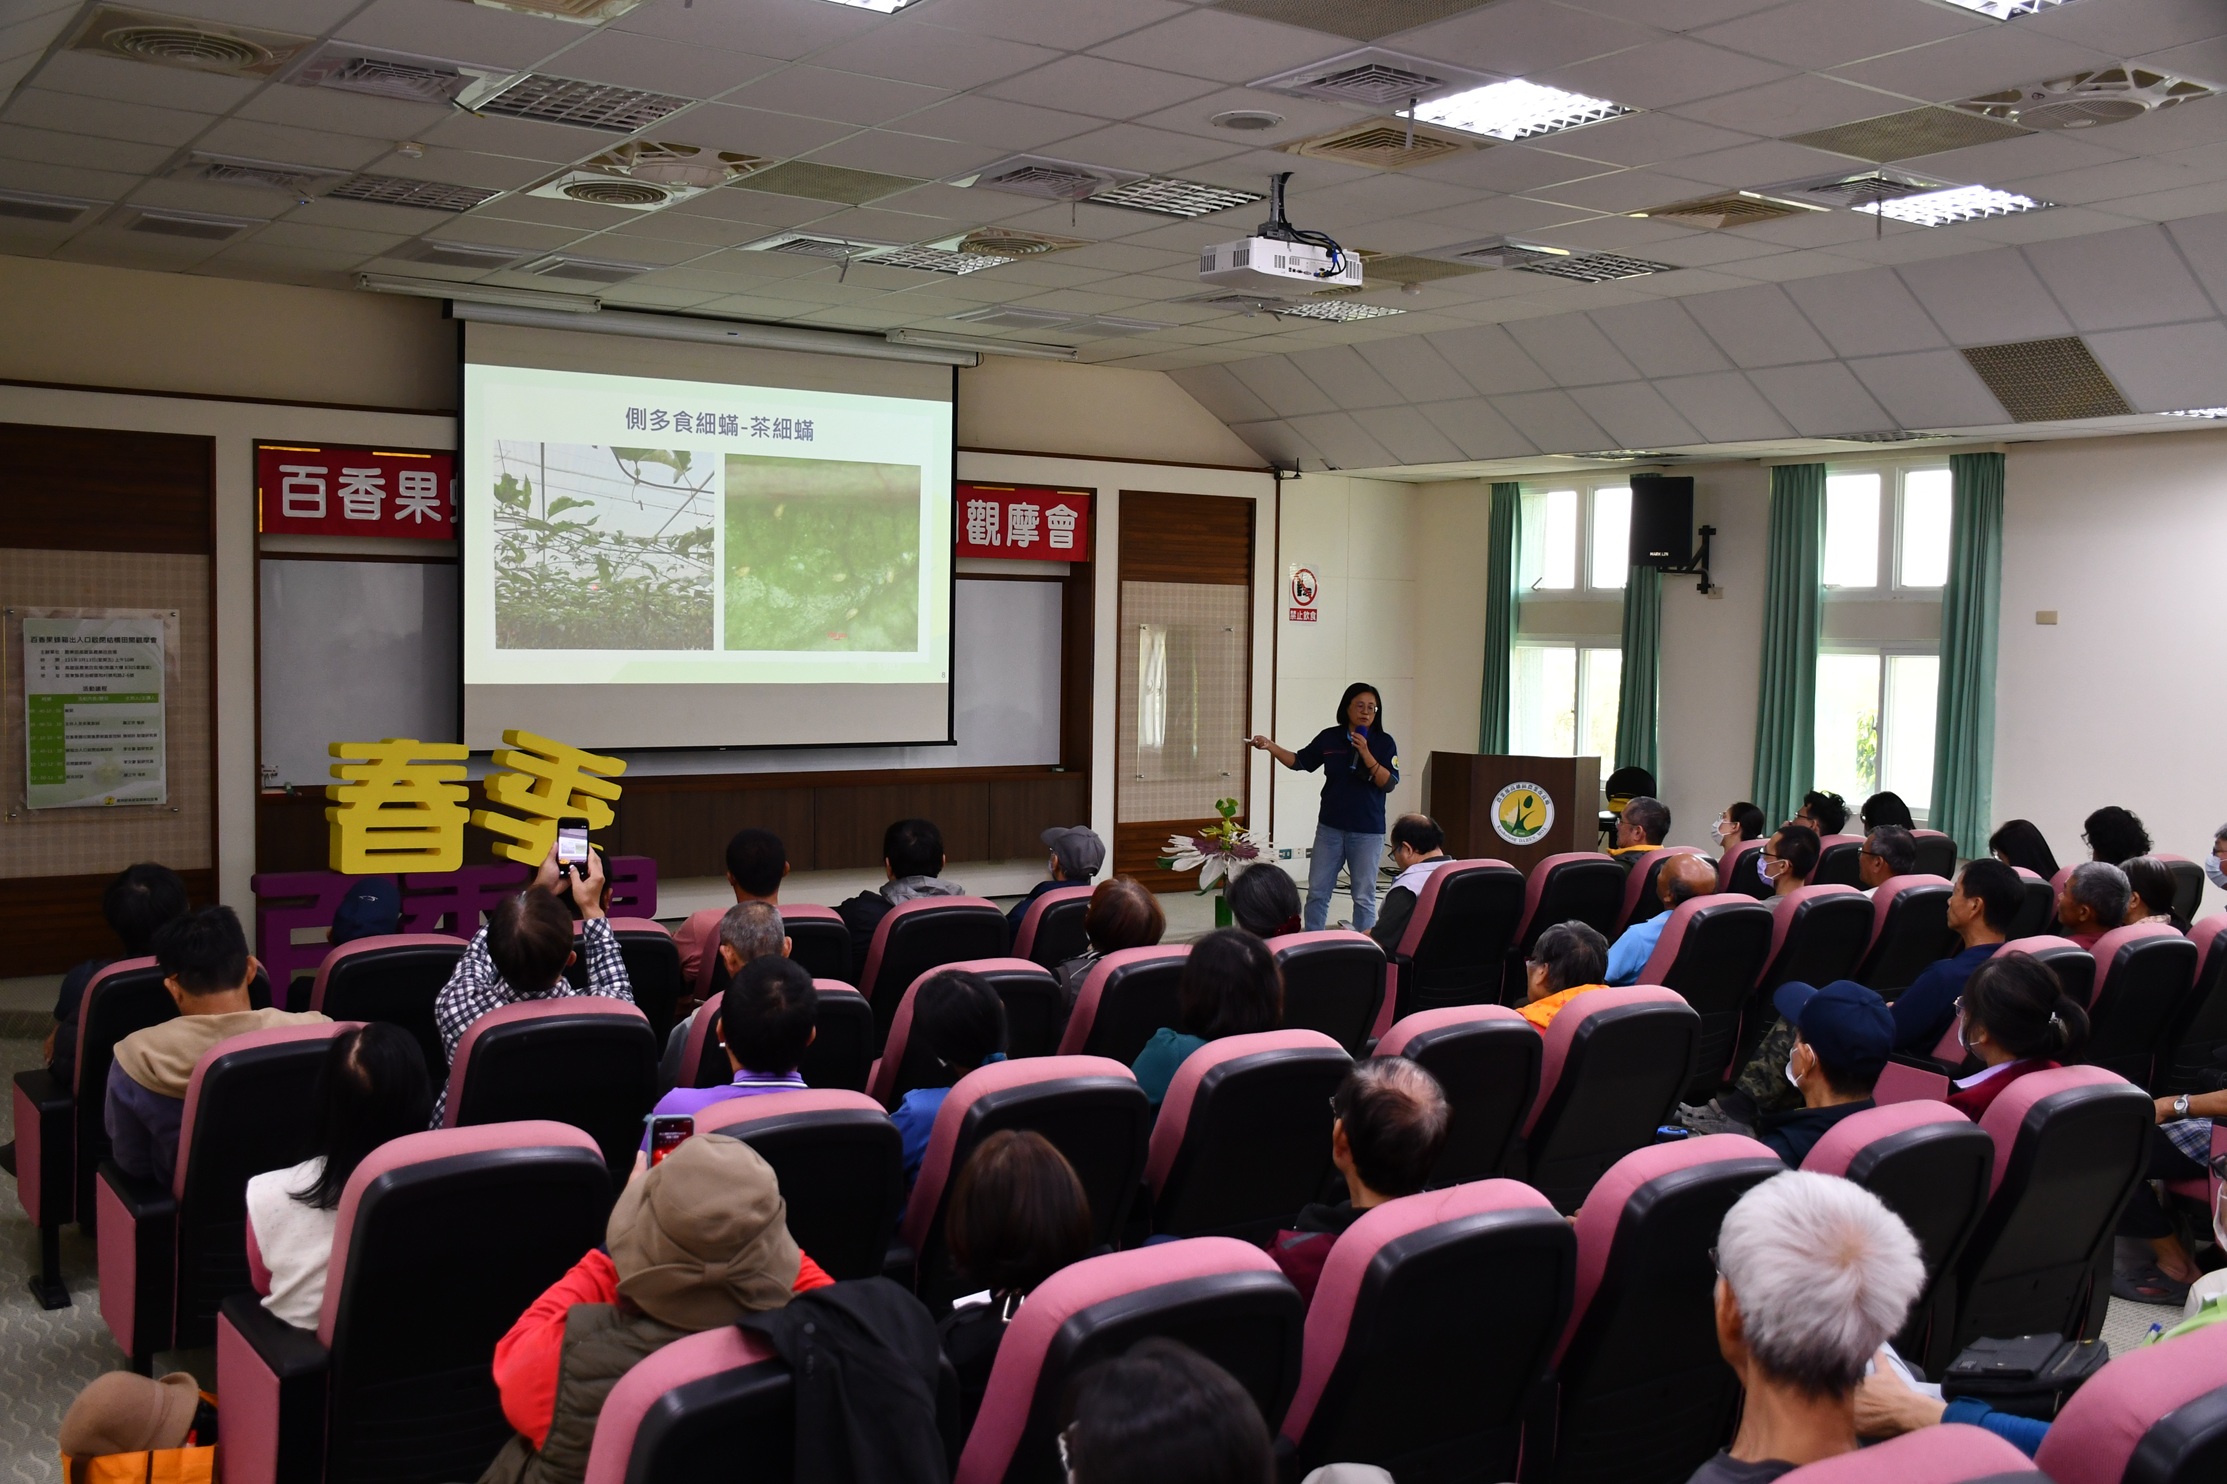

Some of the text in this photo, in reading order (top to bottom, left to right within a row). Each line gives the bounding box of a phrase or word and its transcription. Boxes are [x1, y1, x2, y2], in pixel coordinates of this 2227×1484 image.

[625, 406, 814, 442] 側多食細蟎-茶細蟎
[279, 464, 458, 524] 百香果
[956, 499, 1078, 549] 觀摩會
[1290, 610, 1316, 621] 禁止飲食
